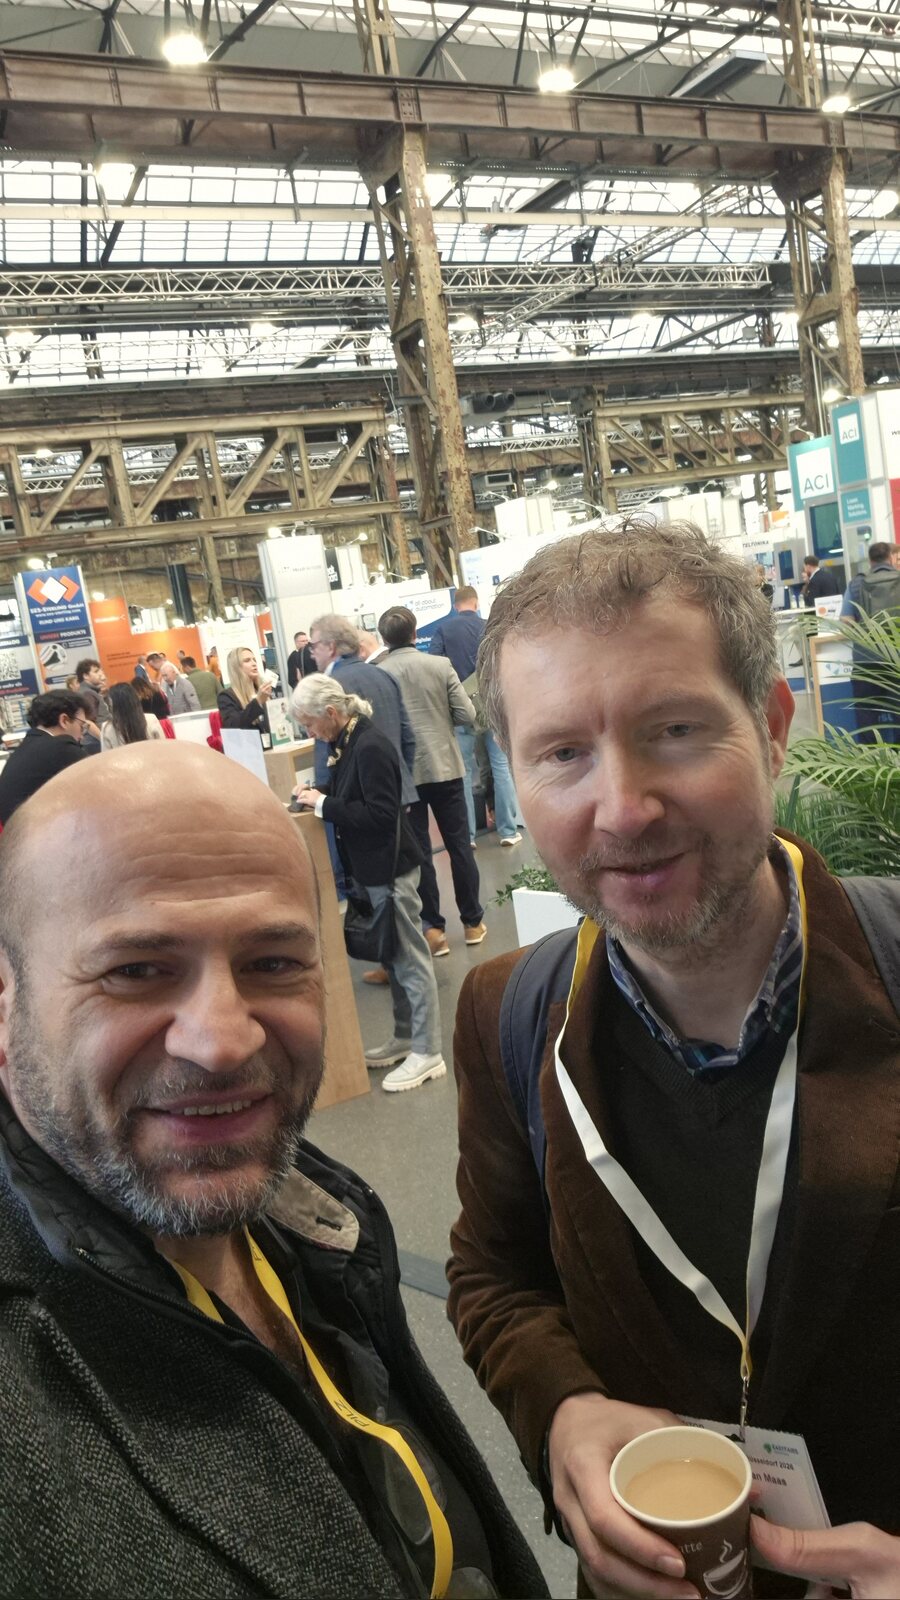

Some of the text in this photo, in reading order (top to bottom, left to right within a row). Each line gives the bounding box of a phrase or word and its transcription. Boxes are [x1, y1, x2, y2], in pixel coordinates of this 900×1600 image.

[842, 427, 857, 440] ACI
[803, 473, 829, 493] ACI
[334, 1399, 370, 1427] PILZ
